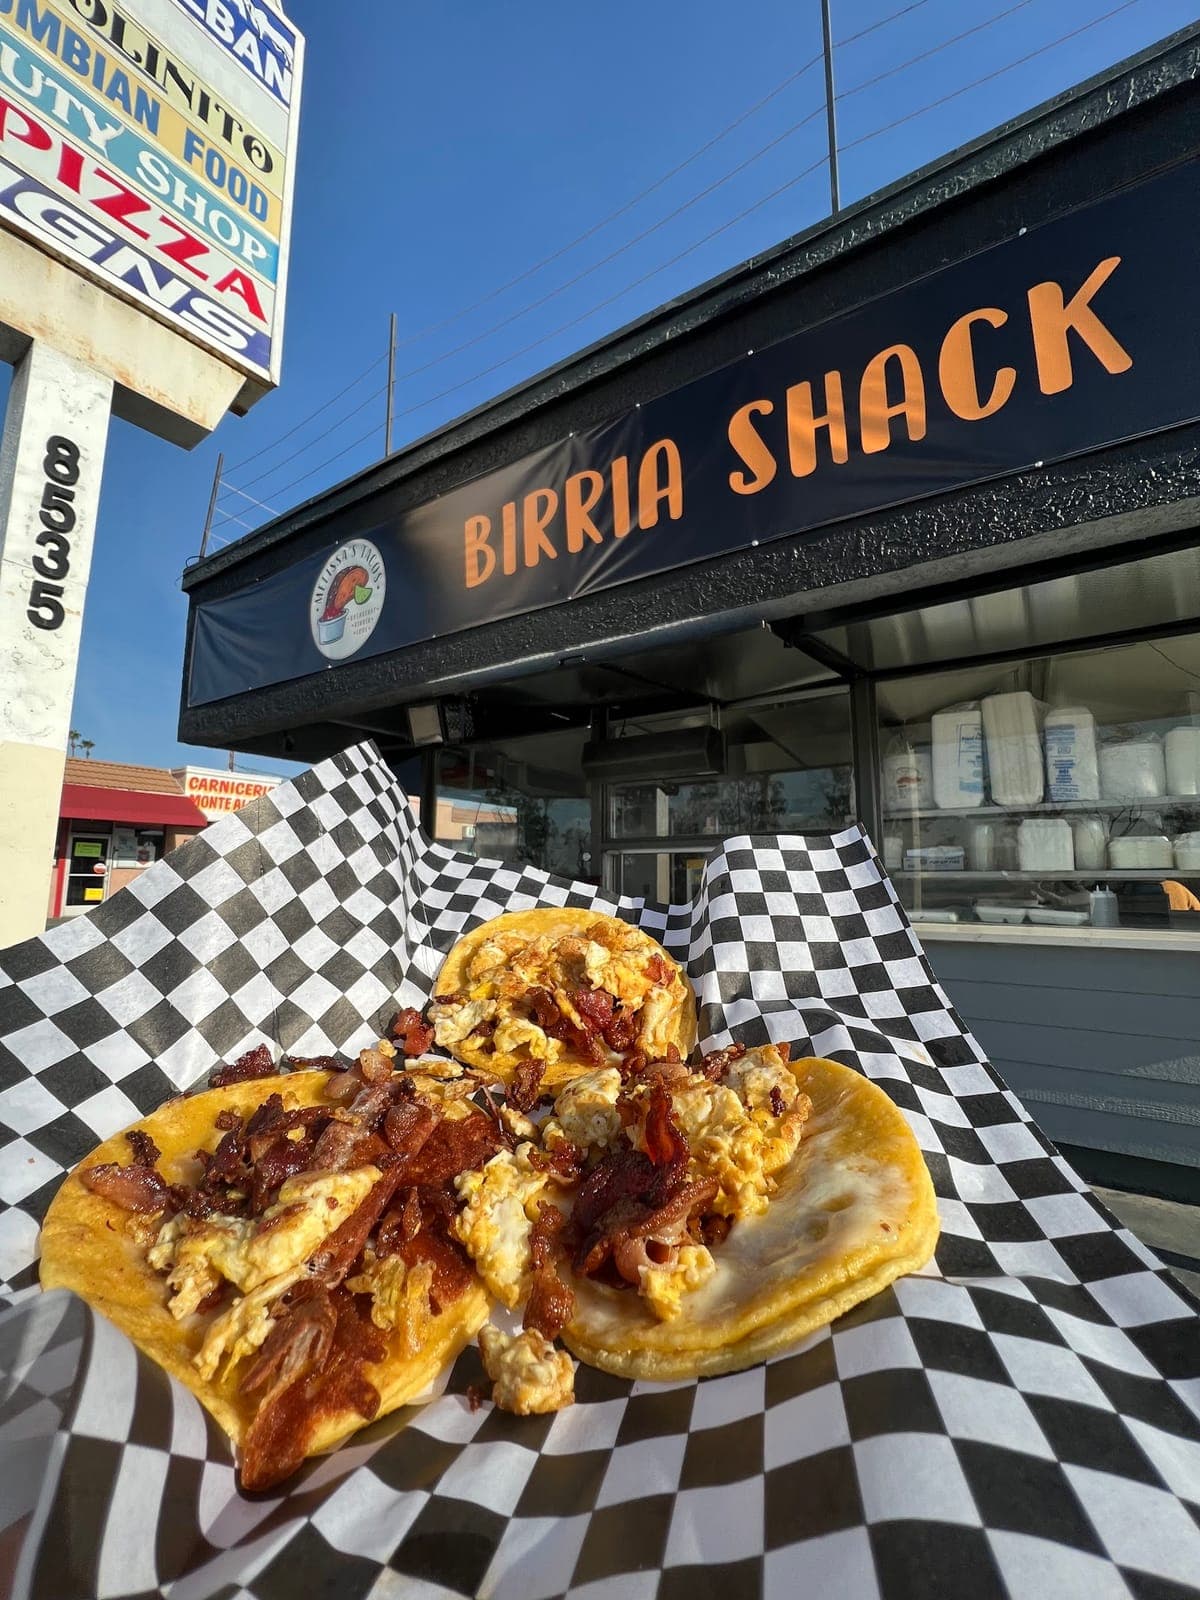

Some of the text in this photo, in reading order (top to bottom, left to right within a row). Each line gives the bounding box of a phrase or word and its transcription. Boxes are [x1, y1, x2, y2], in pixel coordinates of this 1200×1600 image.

[0, 42, 271, 262] UTY SHOP
[177, 0, 292, 104] BAN
[0, 96, 267, 324] PIZZA
[182, 126, 269, 223] FOOD
[464, 256, 1133, 589] BIRRIA SHACK
[27, 435, 80, 630] 8535
